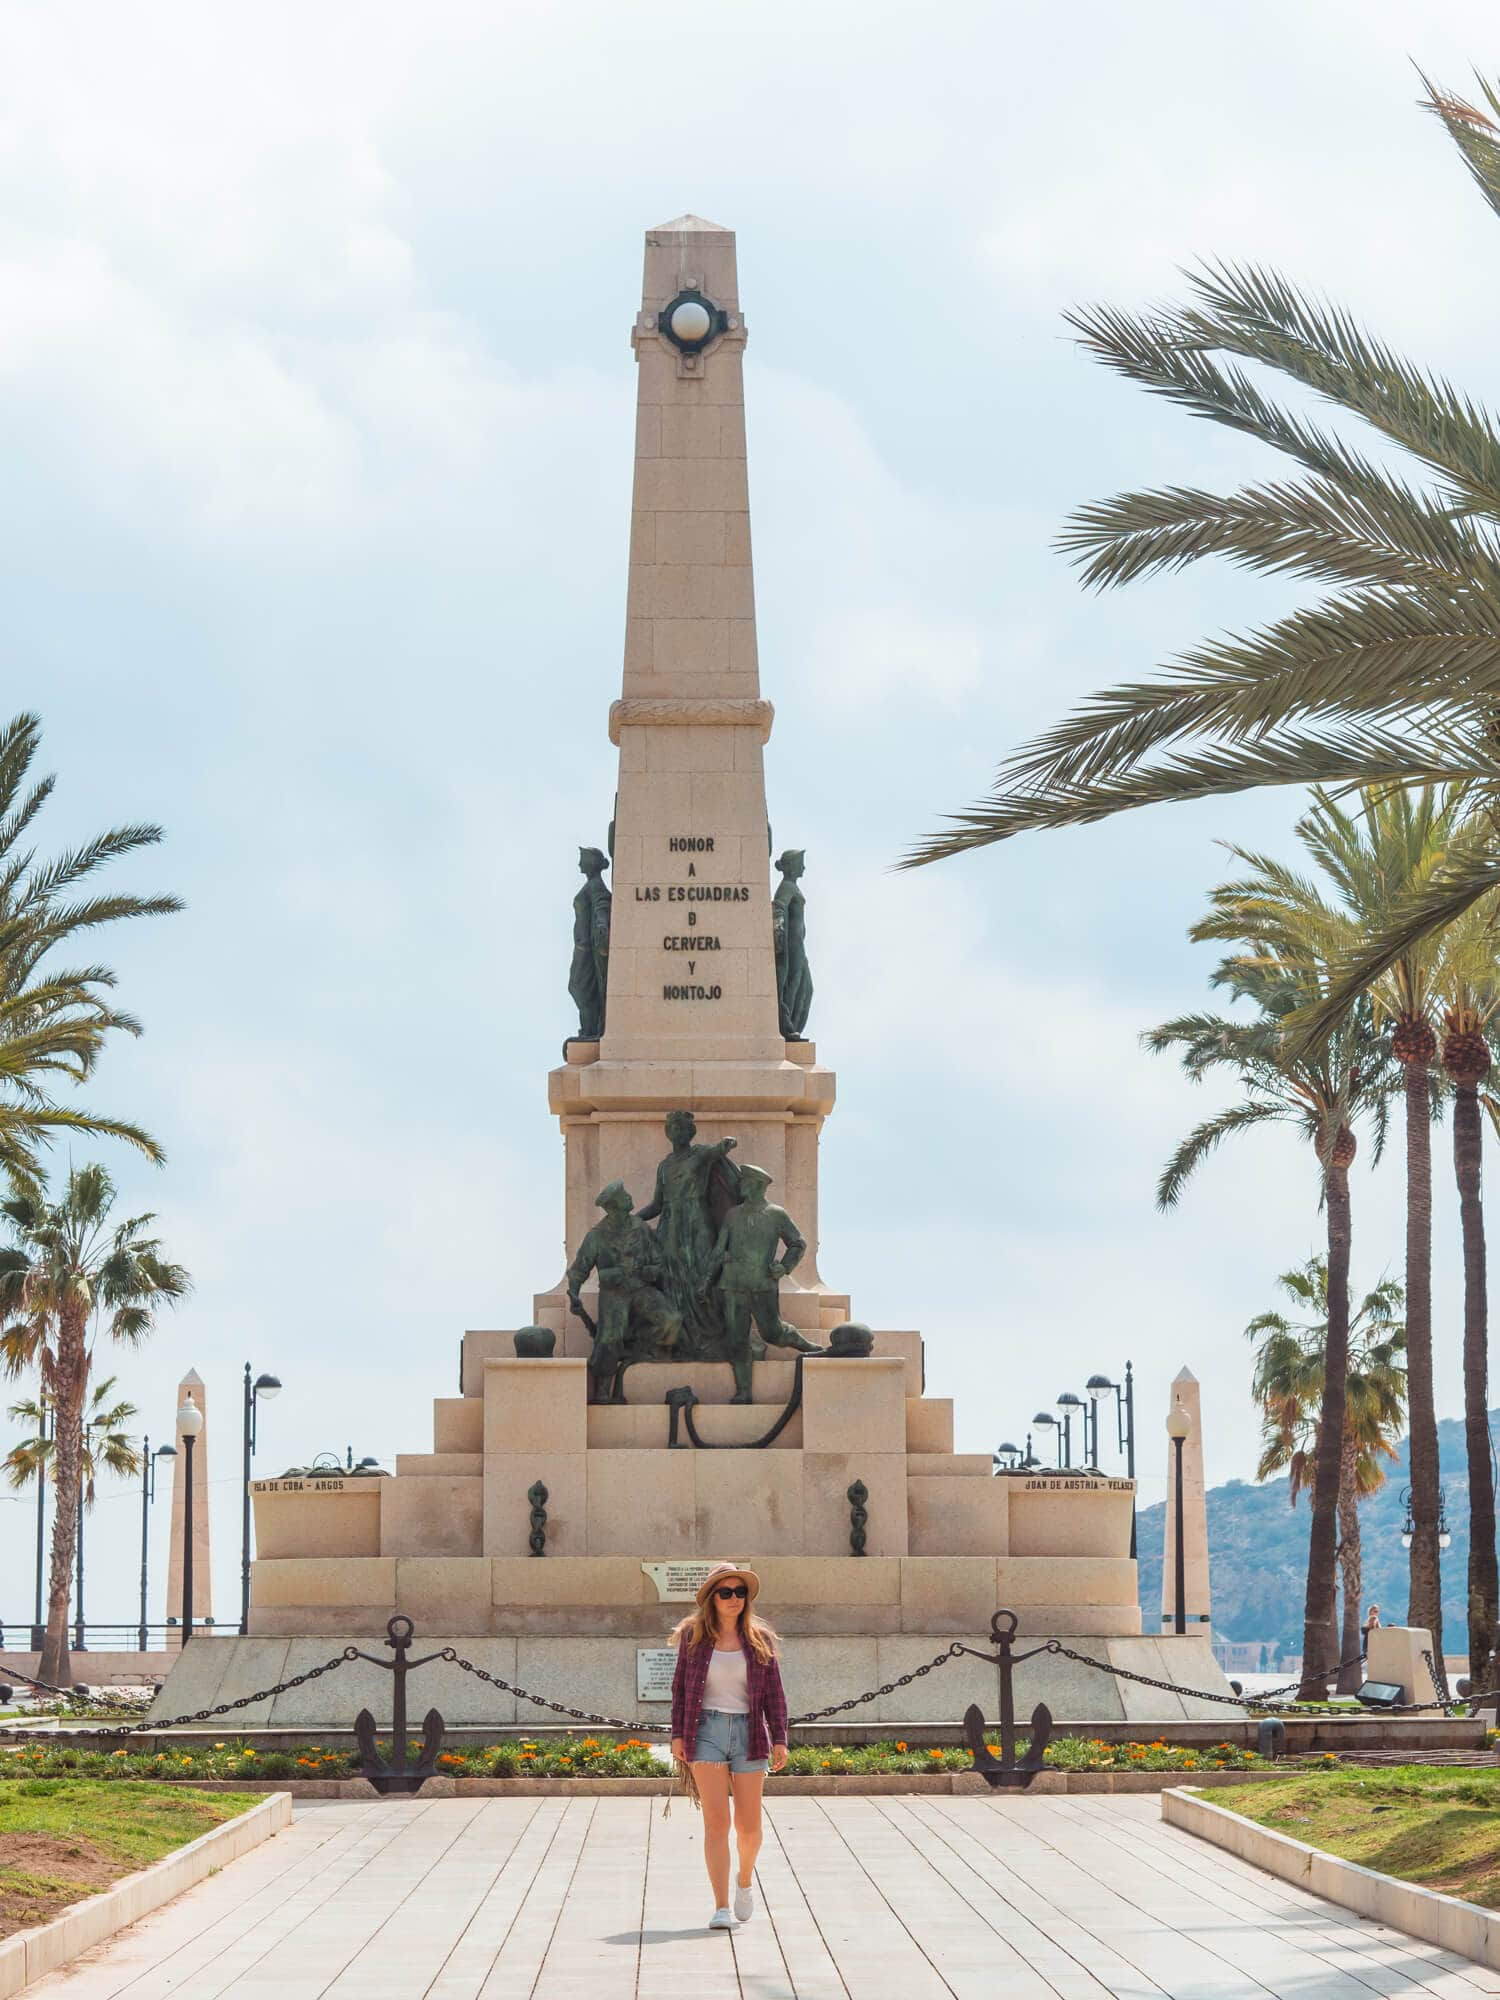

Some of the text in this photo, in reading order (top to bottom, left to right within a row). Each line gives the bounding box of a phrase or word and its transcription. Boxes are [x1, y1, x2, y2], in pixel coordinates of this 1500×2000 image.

[669, 837, 715, 852] HONOR
[688, 862, 696, 877] A
[635, 887, 749, 902] LAS ESCUADRAS
[663, 936, 721, 951] CERVERA
[688, 961, 696, 975] Y
[663, 985, 722, 1000] MONTOJO
[269, 1482, 278, 1492] DE
[283, 1481, 304, 1491] CUBA
[315, 1480, 344, 1490] ARGOS
[1025, 1480, 1047, 1490] JUAN
[1050, 1480, 1061, 1490] DE
[1064, 1480, 1099, 1490] AUSTRIA
